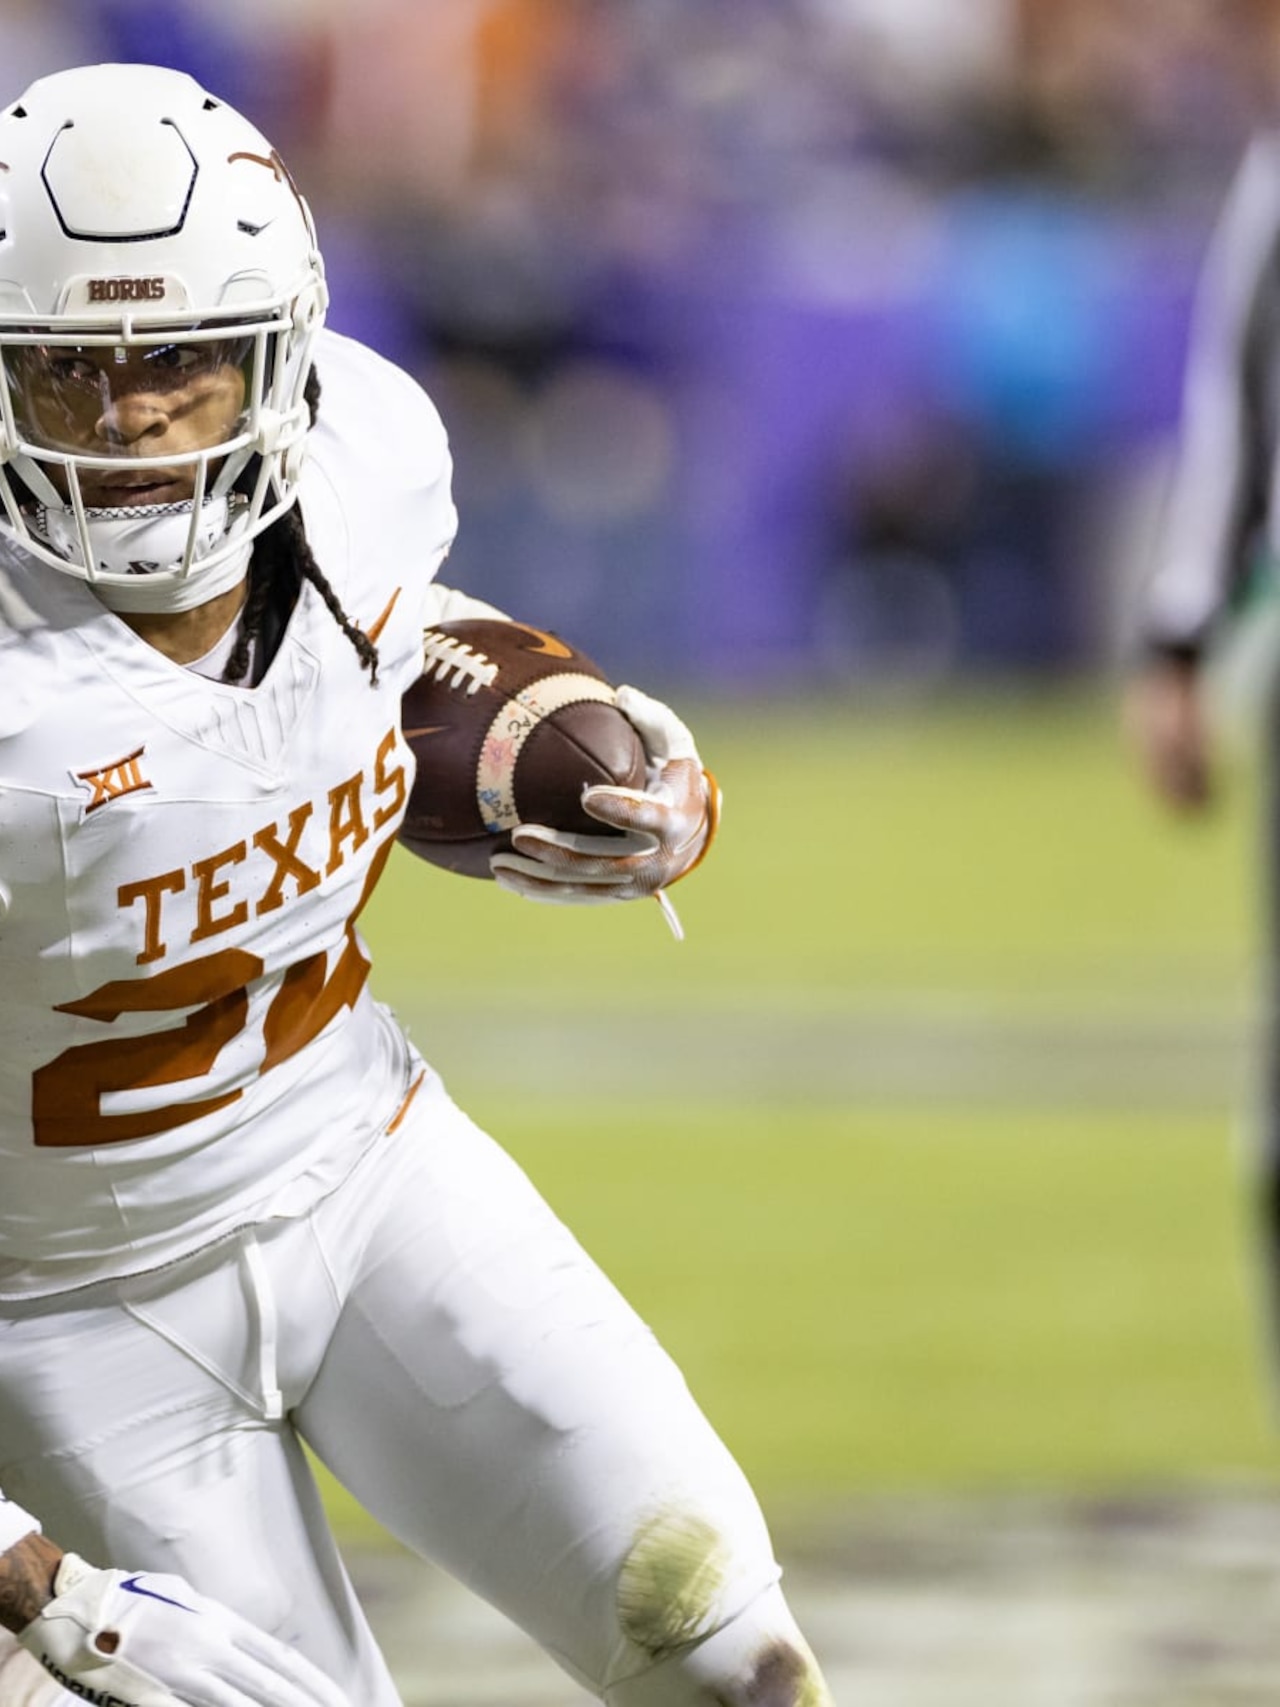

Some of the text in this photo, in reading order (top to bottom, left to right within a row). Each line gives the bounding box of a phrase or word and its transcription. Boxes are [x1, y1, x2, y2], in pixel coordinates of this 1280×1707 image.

[87, 277, 165, 303] HORNS
[76, 745, 152, 815] XII
[117, 726, 406, 966] TEXAS
